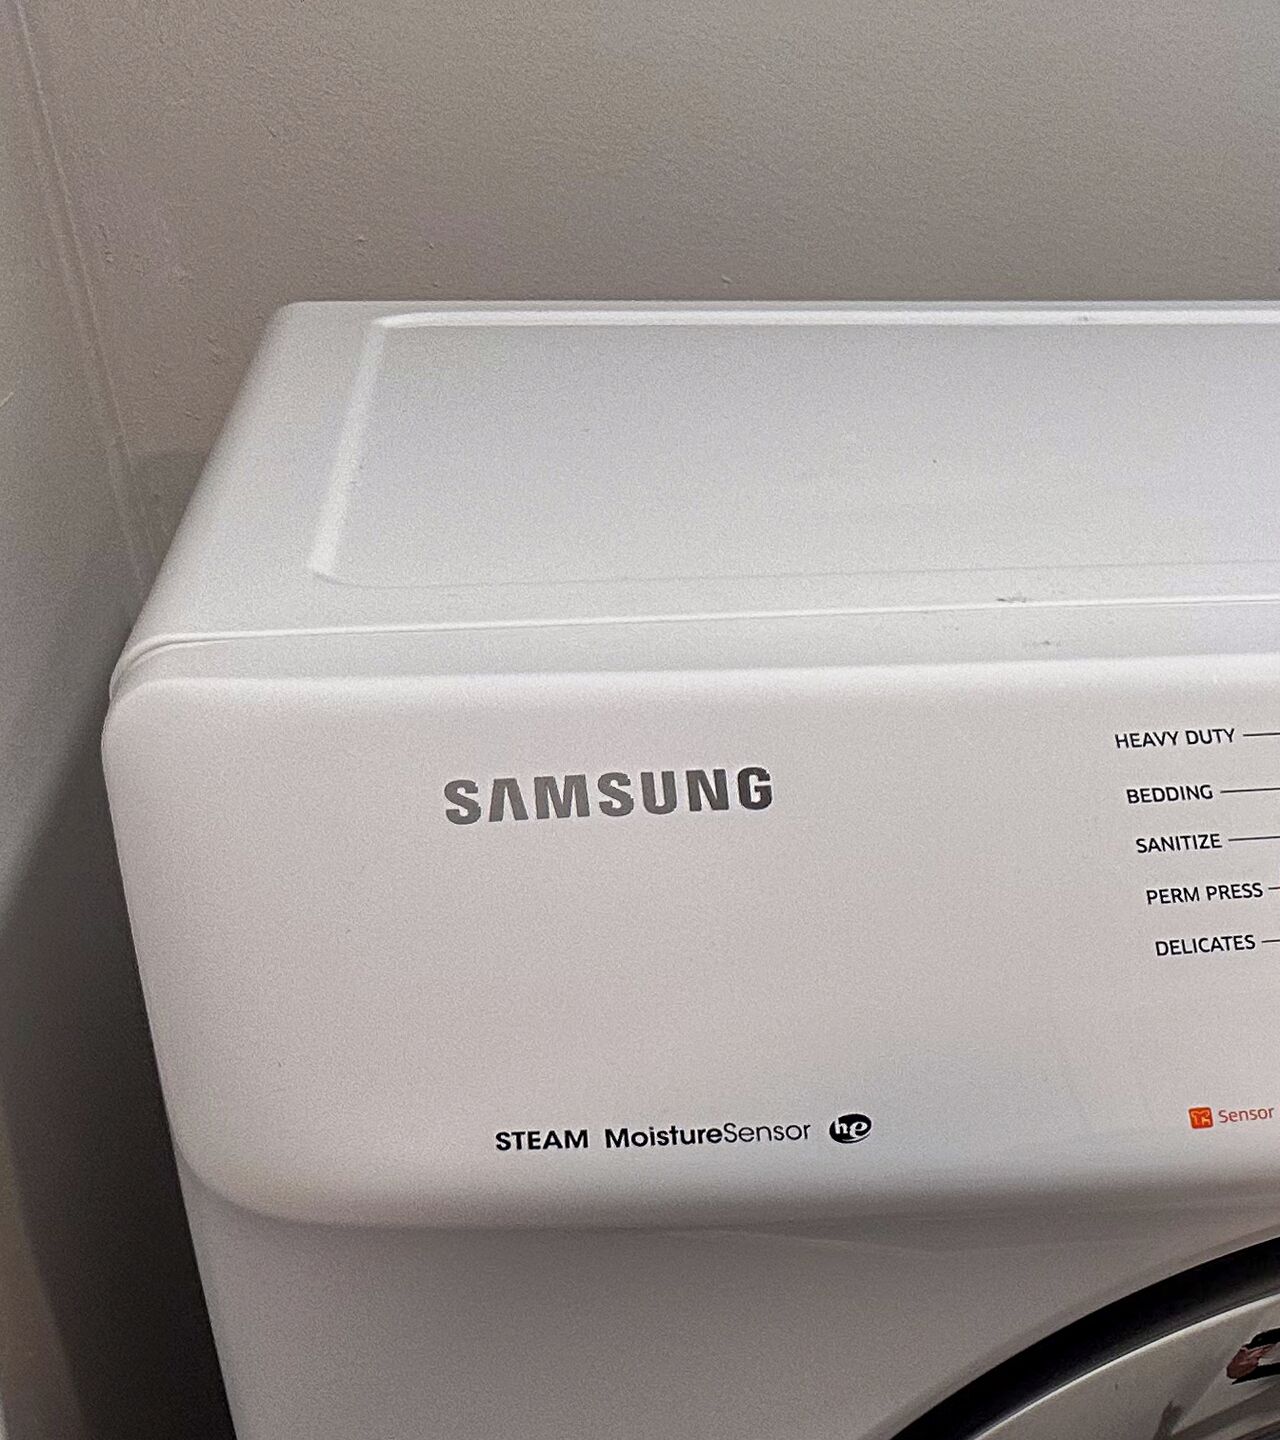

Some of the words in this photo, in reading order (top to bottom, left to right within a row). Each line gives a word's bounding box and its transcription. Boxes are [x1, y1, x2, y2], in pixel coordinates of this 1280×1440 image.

[1114, 731, 1179, 749] HEAVY
[1185, 728, 1235, 745] DUTY
[443, 766, 773, 825] SAMSUNG
[1126, 785, 1214, 804] BEDDING
[1136, 833, 1223, 853] SANITIZE
[1146, 886, 1201, 905] PERM
[1206, 882, 1264, 901] PRESS
[1155, 934, 1256, 956] DELICATES
[1218, 1107, 1275, 1124] Sensor
[495, 1129, 589, 1152] STEAM
